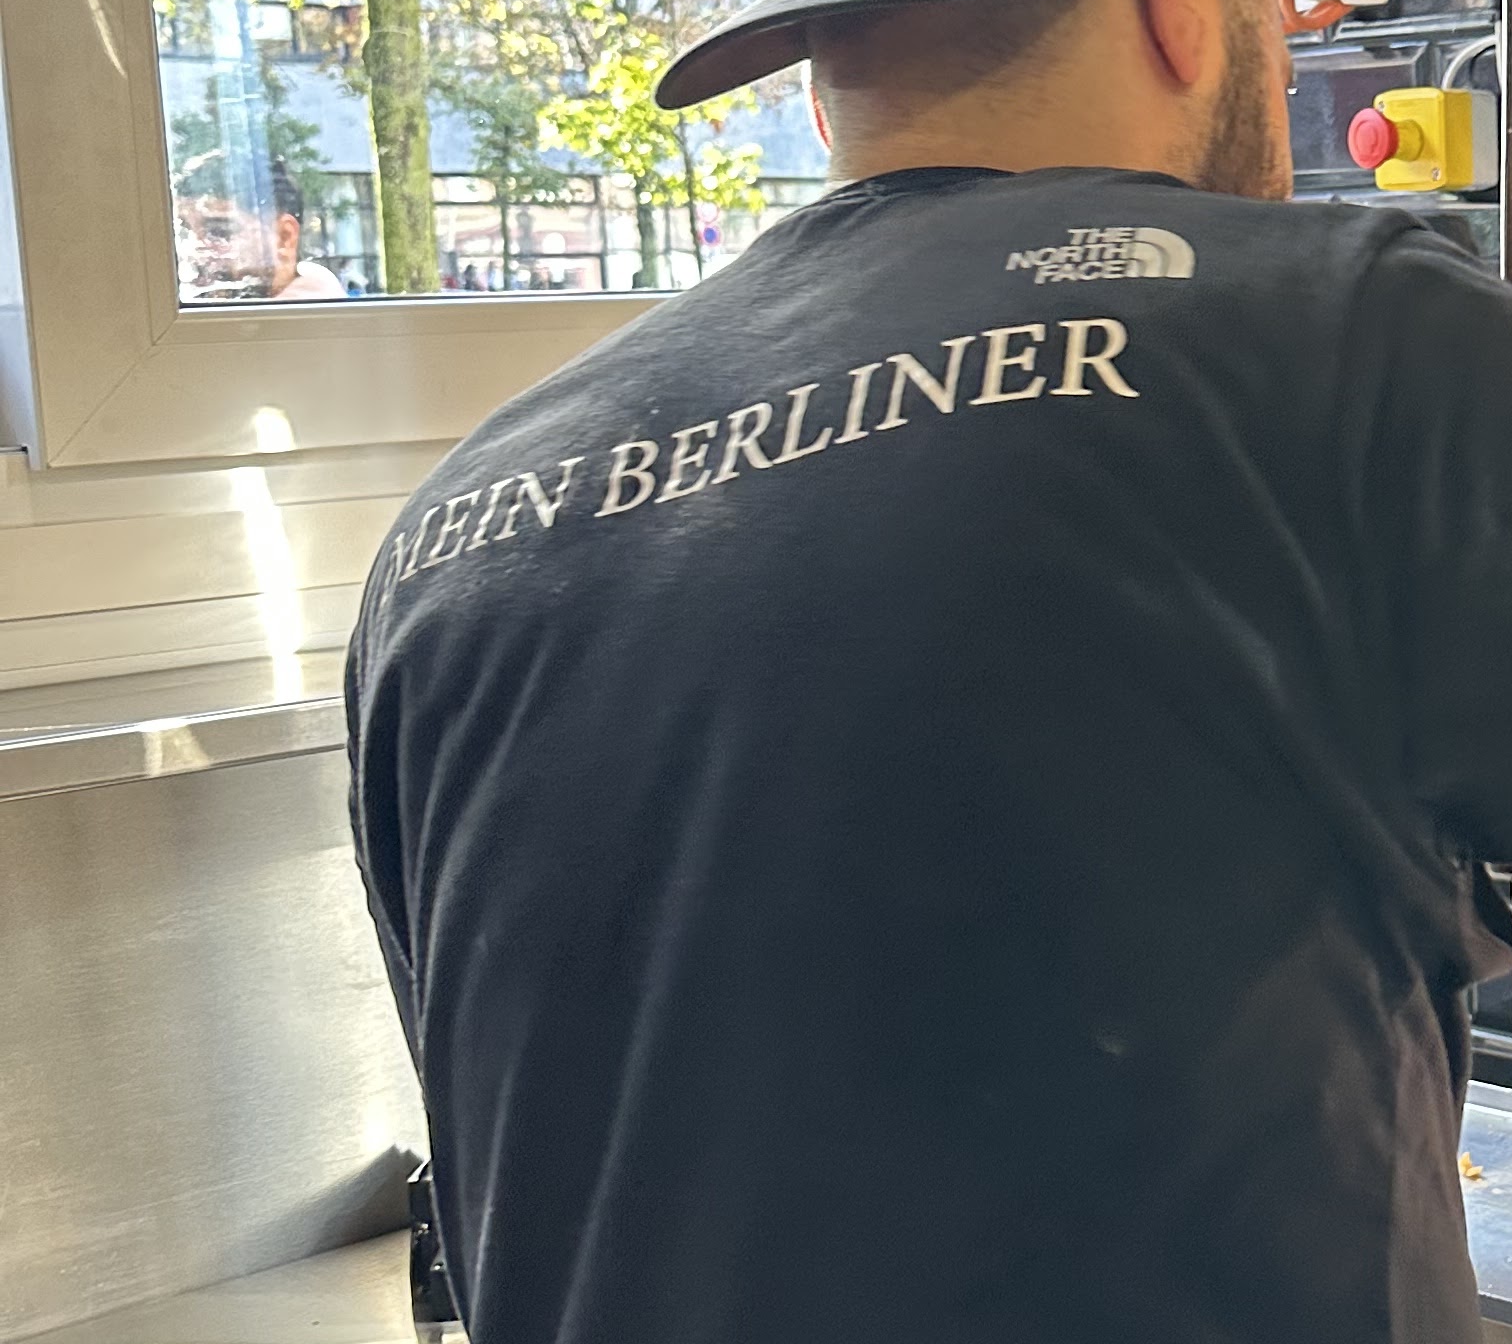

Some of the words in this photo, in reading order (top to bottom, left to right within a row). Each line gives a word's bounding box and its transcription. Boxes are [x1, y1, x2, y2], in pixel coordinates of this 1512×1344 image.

[1067, 227, 1135, 246] THE
[1005, 242, 1128, 271] NORTH
[1034, 259, 1128, 285] FACE
[594, 316, 1140, 518] BERLINER
